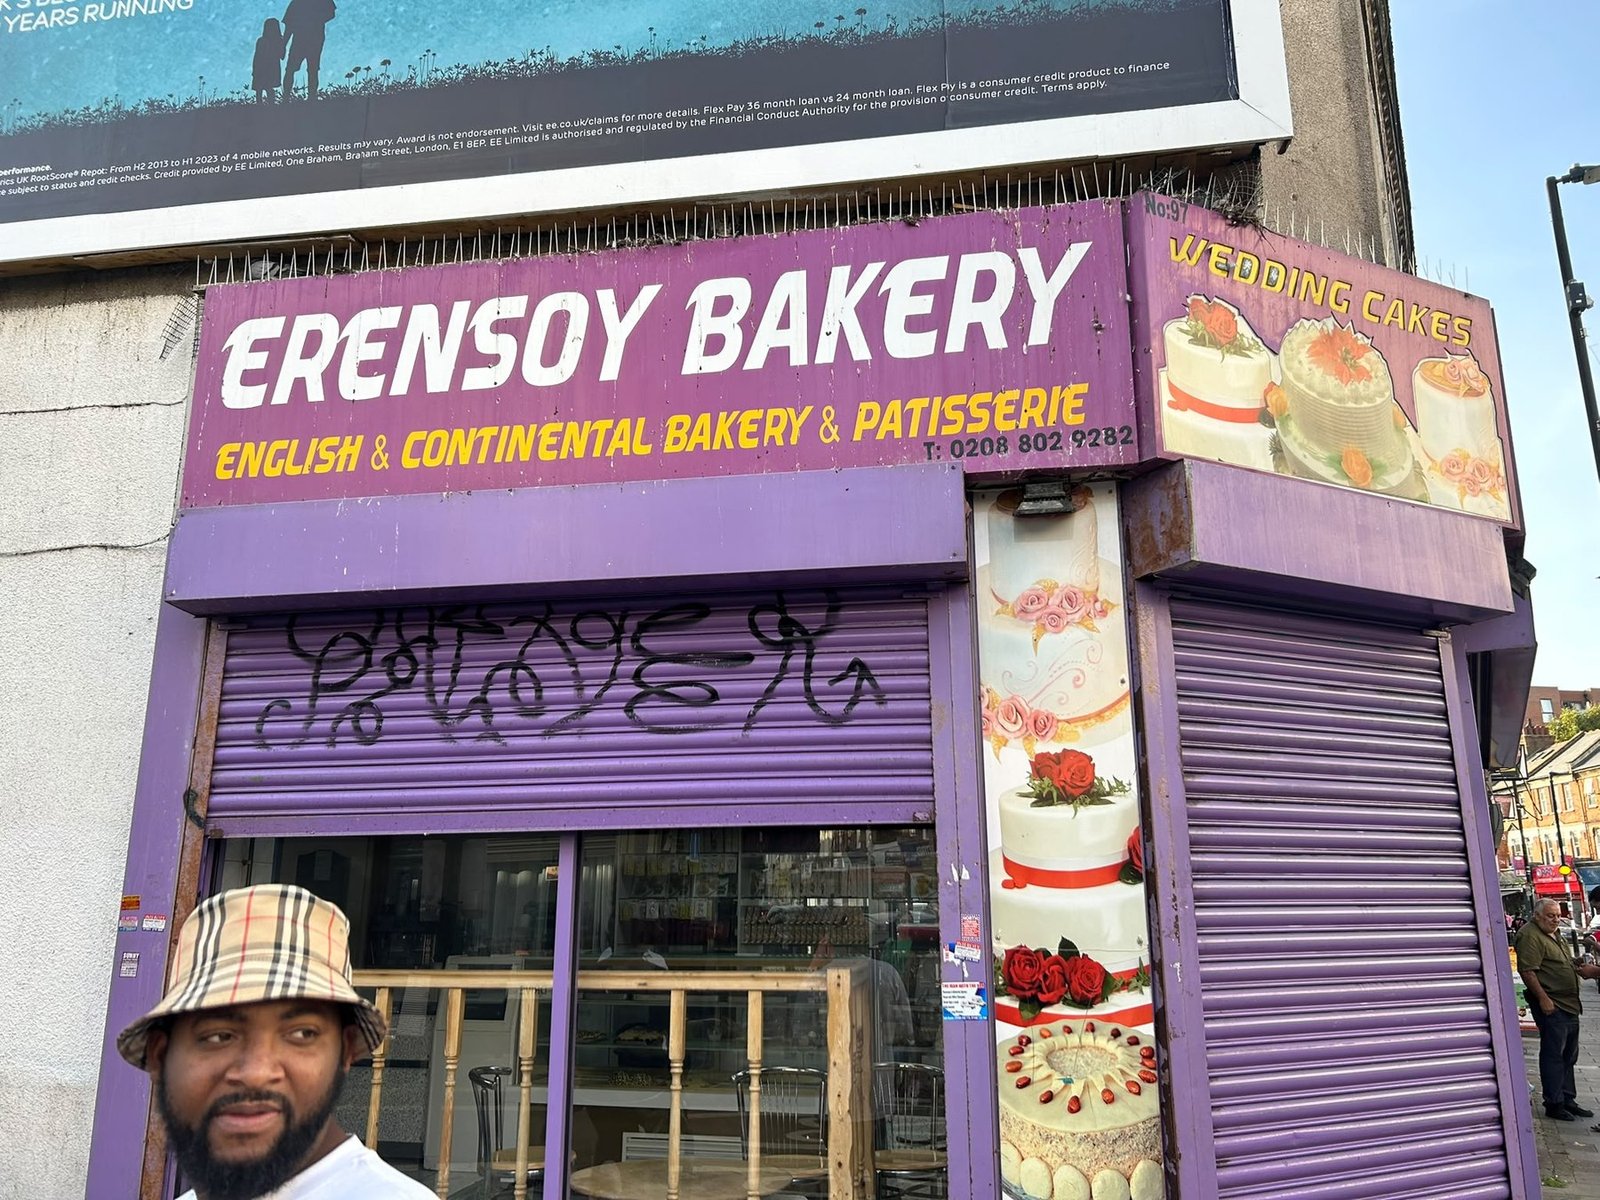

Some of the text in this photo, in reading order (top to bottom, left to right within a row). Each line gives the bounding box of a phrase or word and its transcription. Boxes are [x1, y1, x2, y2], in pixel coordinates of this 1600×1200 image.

[4, 6, 80, 33] YEARS
[8, 181, 39, 196] subject
[40, 181, 50, 191] to
[51, 178, 78, 189] status
[79, 175, 96, 186] and
[120, 170, 152, 182] checks.
[154, 166, 181, 179] Credit
[182, 162, 221, 179] provided
[222, 161, 234, 174] by
[235, 160, 247, 170] EE
[249, 156, 284, 169] Limited,
[286, 155, 305, 165] One
[307, 151, 343, 163] Braham,
[382, 144, 413, 156] Street,
[415, 141, 451, 152] London,
[454, 138, 464, 149] E1
[467, 136, 487, 147] 8EP.
[490, 134, 503, 145] EE
[505, 131, 540, 144] Limited
[542, 130, 550, 140] is
[552, 125, 603, 139] authorised
[606, 123, 624, 134] and
[626, 118, 673, 134] regulated
[676, 117, 688, 130] by
[690, 116, 707, 126] the
[710, 111, 754, 124] Financial
[757, 106, 800, 120] Conduct
[802, 102, 851, 116] Authority
[853, 101, 868, 111] for
[870, 99, 888, 109] the
[891, 94, 937, 110] provision
[940, 92, 949, 103] o
[950, 90, 1002, 102] consumer
[1004, 84, 1039, 97] credit.
[1042, 83, 1074, 93] Terms
[1077, 79, 1108, 92] apply.
[17, 172, 29, 183] UK
[110, 163, 132, 173] From
[134, 160, 147, 170] H2
[148, 157, 170, 169] 2013
[171, 156, 181, 167] to
[182, 155, 193, 165] H1
[195, 152, 220, 164] 2023
[221, 151, 231, 161] of
[232, 150, 240, 160] 4
[241, 147, 271, 159] mobile
[273, 143, 316, 156] networks.
[318, 139, 352, 151] Results
[373, 137, 394, 148] vary.
[397, 131, 426, 144] Award
[428, 131, 436, 141] is
[438, 128, 454, 140] not
[456, 123, 520, 138] endorsement.
[522, 120, 544, 131] Visit
[546, 113, 619, 129] ee.co.uk/claims
[622, 112, 636, 122] for
[638, 111, 663, 120] more
[666, 105, 701, 117] details.
[704, 103, 724, 114] Flex
[727, 101, 745, 113] Pay
[747, 99, 761, 109] 36
[764, 95, 796, 108] month
[799, 94, 820, 104] loan
[823, 94, 834, 102] vs
[836, 90, 850, 101] 24
[853, 86, 886, 99] month
[889, 86, 913, 96] loan.
[917, 82, 938, 93] Flex
[959, 79, 968, 89] is
[970, 80, 976, 88] a
[979, 75, 1032, 87] consumer
[1034, 69, 1066, 81] credit
[1069, 65, 1112, 81] product
[1114, 64, 1126, 74] to
[1128, 61, 1170, 72] finance
[1145, 191, 1188, 224] No:97
[221, 241, 1093, 409] ERENSOY BAKERY
[1169, 234, 1473, 347] WEDDING CAKES
[215, 383, 1089, 480] ENGLISH & CONTINENTAL BAKERY & PATISSERIE
[923, 425, 1134, 461] T: 0208 802 9282
